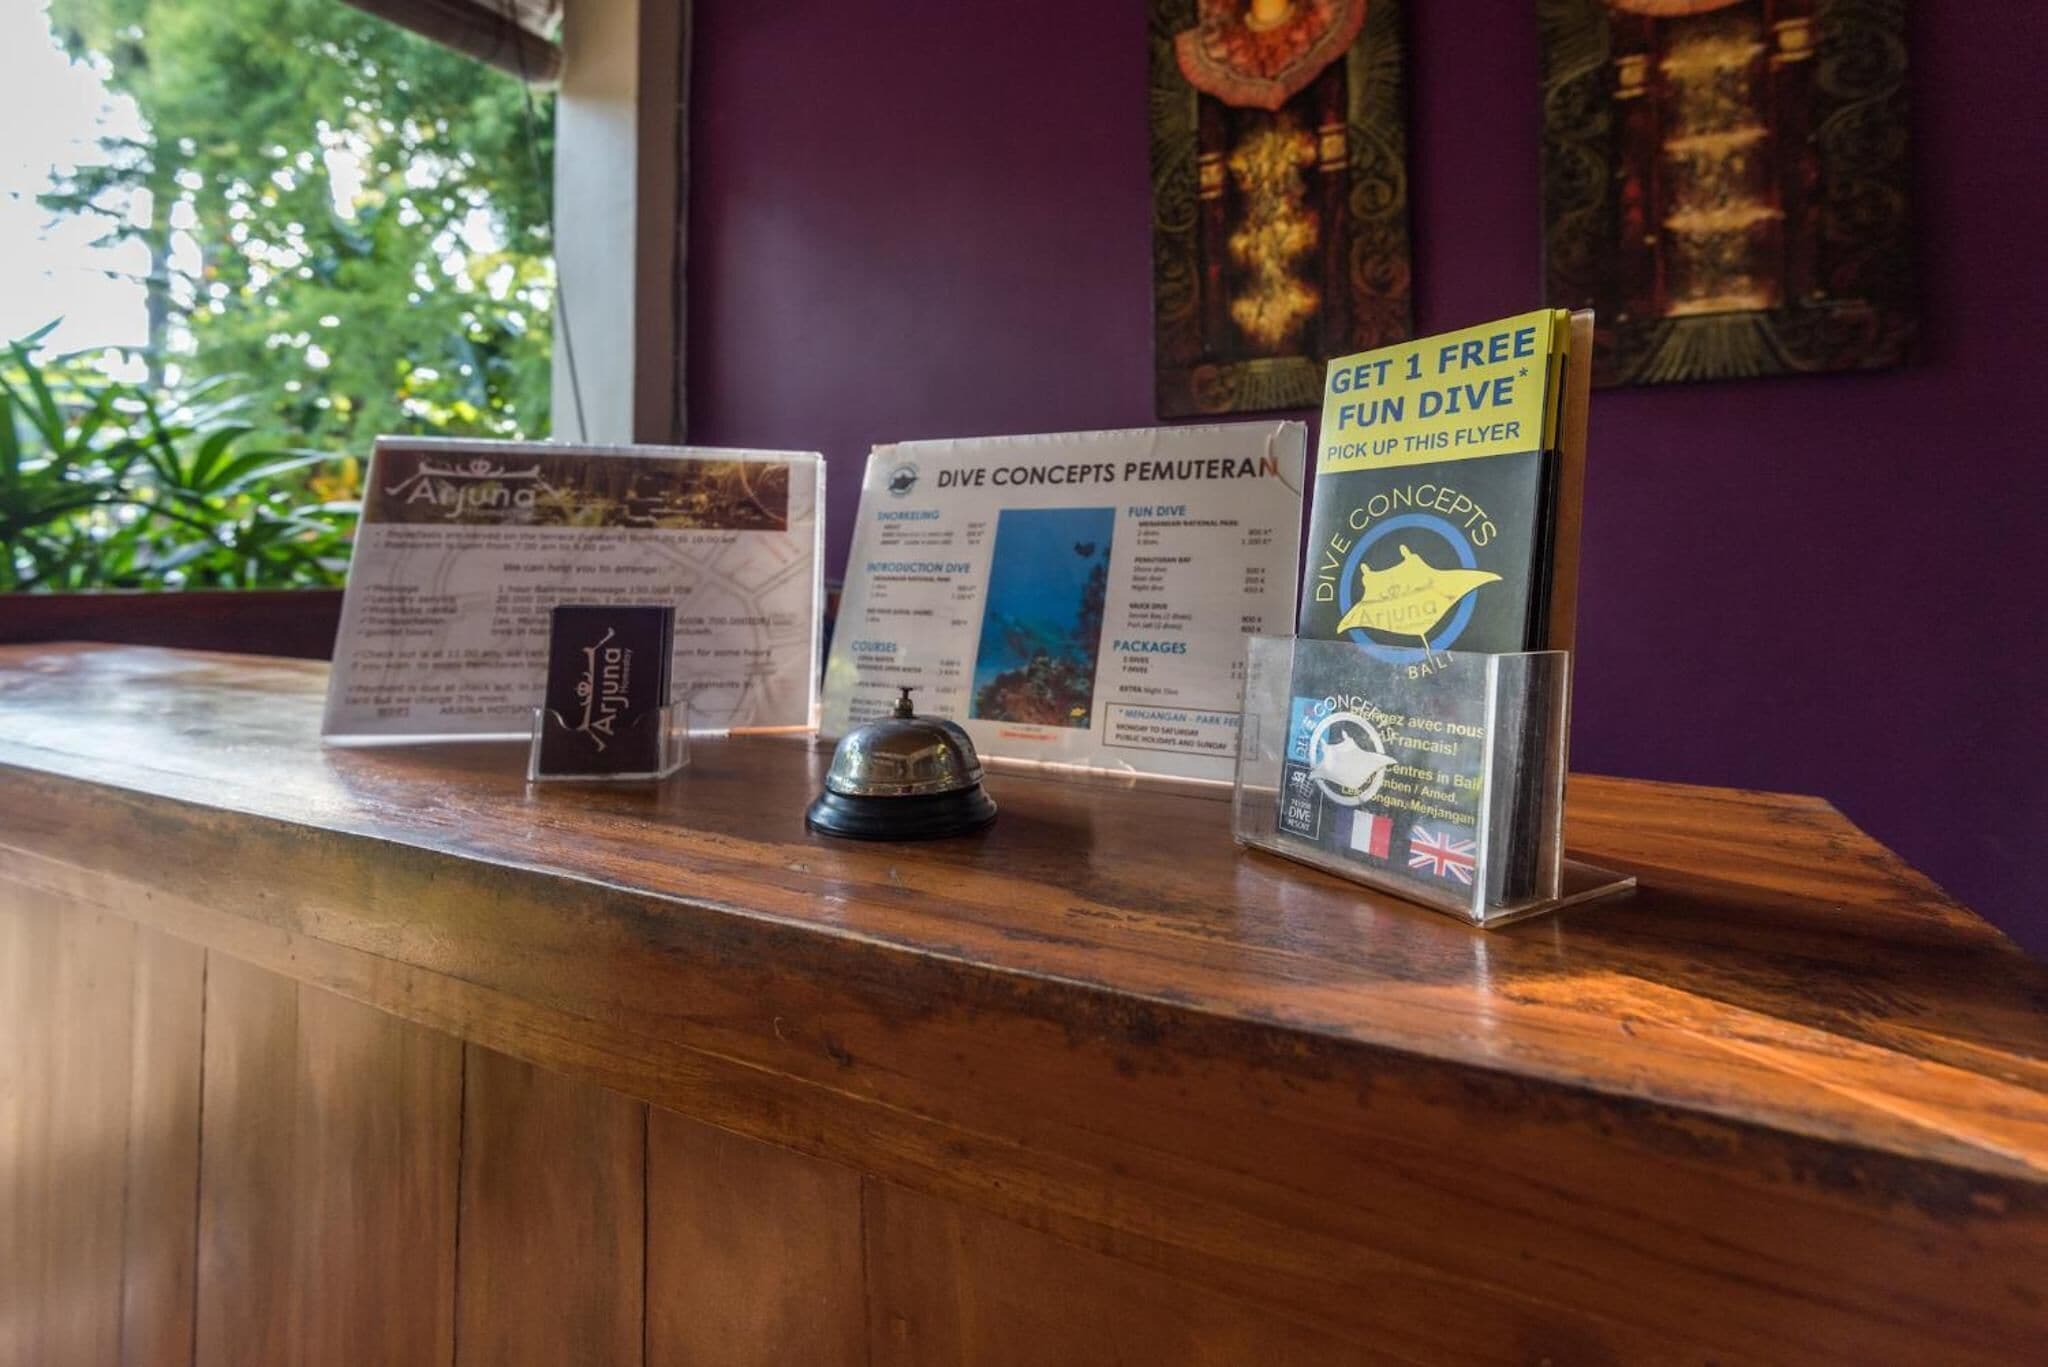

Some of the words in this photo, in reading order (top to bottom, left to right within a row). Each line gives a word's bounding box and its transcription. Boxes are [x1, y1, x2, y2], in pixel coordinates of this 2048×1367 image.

[1331, 359, 1394, 394] GET
[1404, 353, 1423, 381] 1
[1438, 326, 1538, 374] FREE
[1338, 396, 1405, 431] FUN
[1327, 441, 1368, 461] PICK
[1373, 437, 1399, 456] UP
[1404, 431, 1449, 452] THIS
[1455, 421, 1521, 447] FLYER
[936, 467, 987, 489] DIVE
[991, 462, 1116, 486] CONCEPTS
[1123, 455, 1279, 482] PEMUTERAN
[405, 476, 537, 518] Arjuna
[1128, 507, 1153, 518] FUN
[1156, 505, 1187, 517] DIVE
[1316, 532, 1351, 601] DIVE
[1349, 483, 1498, 547] CONCEPTS
[866, 562, 944, 574] INTRODUCTION
[945, 563, 971, 574] DIVE
[851, 640, 897, 652] COURSES
[1112, 638, 1188, 654] PACKAGES
[1407, 652, 1455, 681] BALI
[591, 647, 630, 736] Arjuna
[1196, 713, 1222, 727] PARK
[1408, 716, 1443, 733] avec
[1446, 722, 1486, 739] nous
[1437, 770, 1450, 785] in
[1287, 806, 1312, 823] DIVE
[1409, 798, 1476, 826] Menjangan
